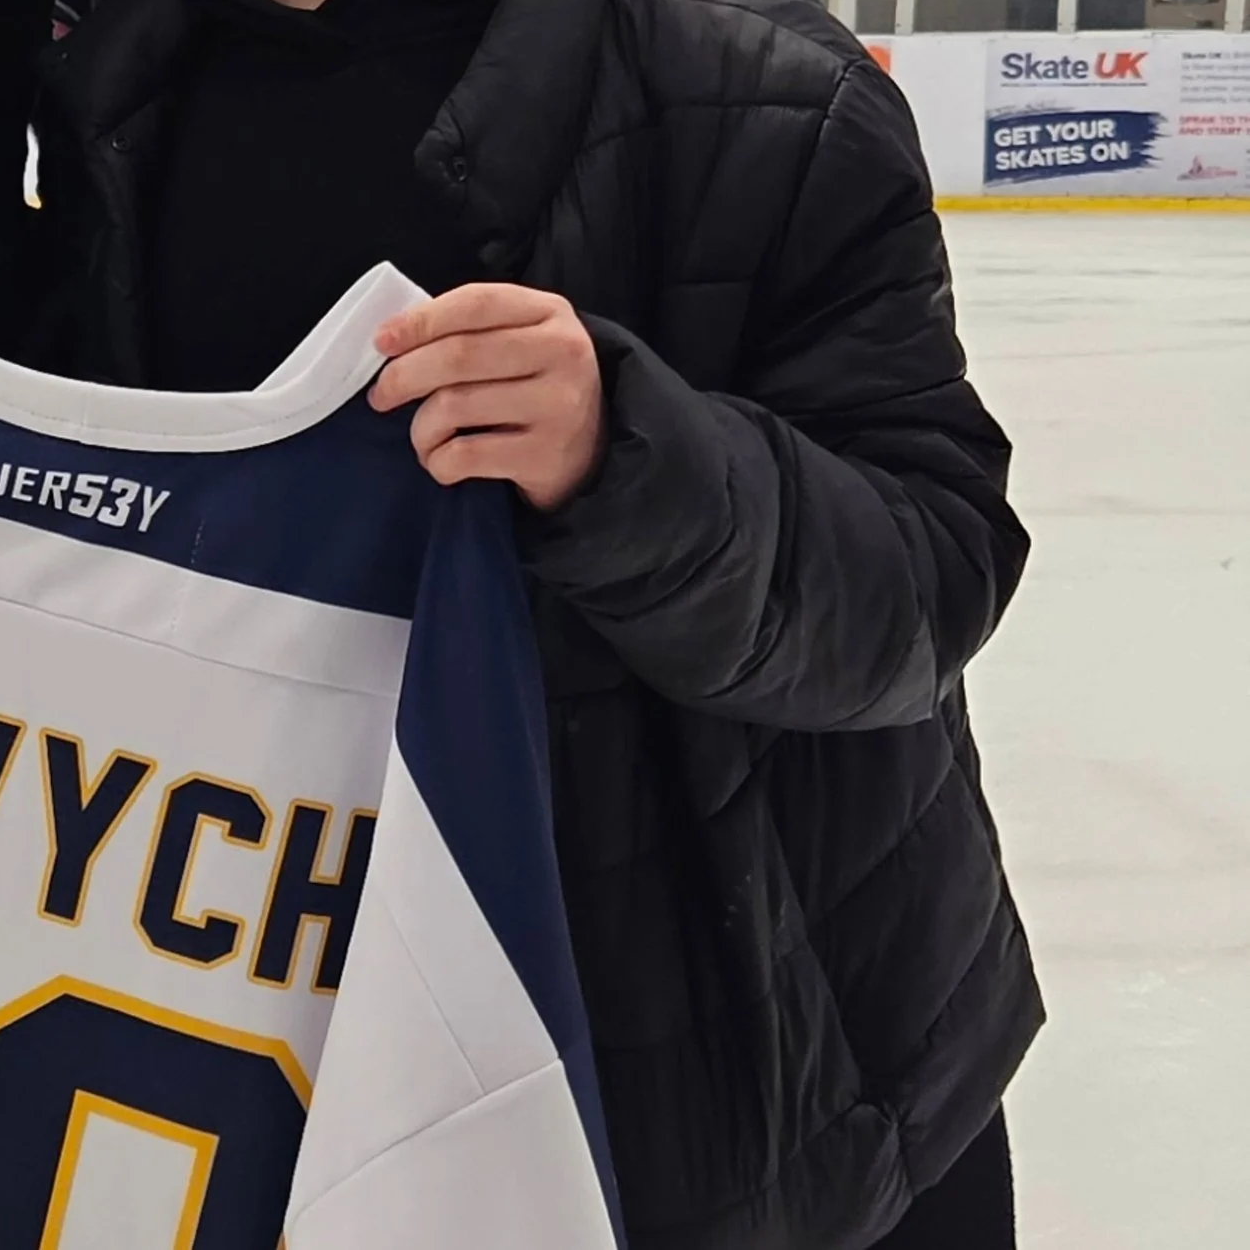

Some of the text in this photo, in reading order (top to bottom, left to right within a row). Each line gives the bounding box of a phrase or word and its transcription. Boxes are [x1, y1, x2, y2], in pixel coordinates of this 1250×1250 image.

[1001, 52, 1148, 79] Skate UK
[994, 119, 1115, 147] GET YOUR
[995, 141, 1129, 170] SKATES ON
